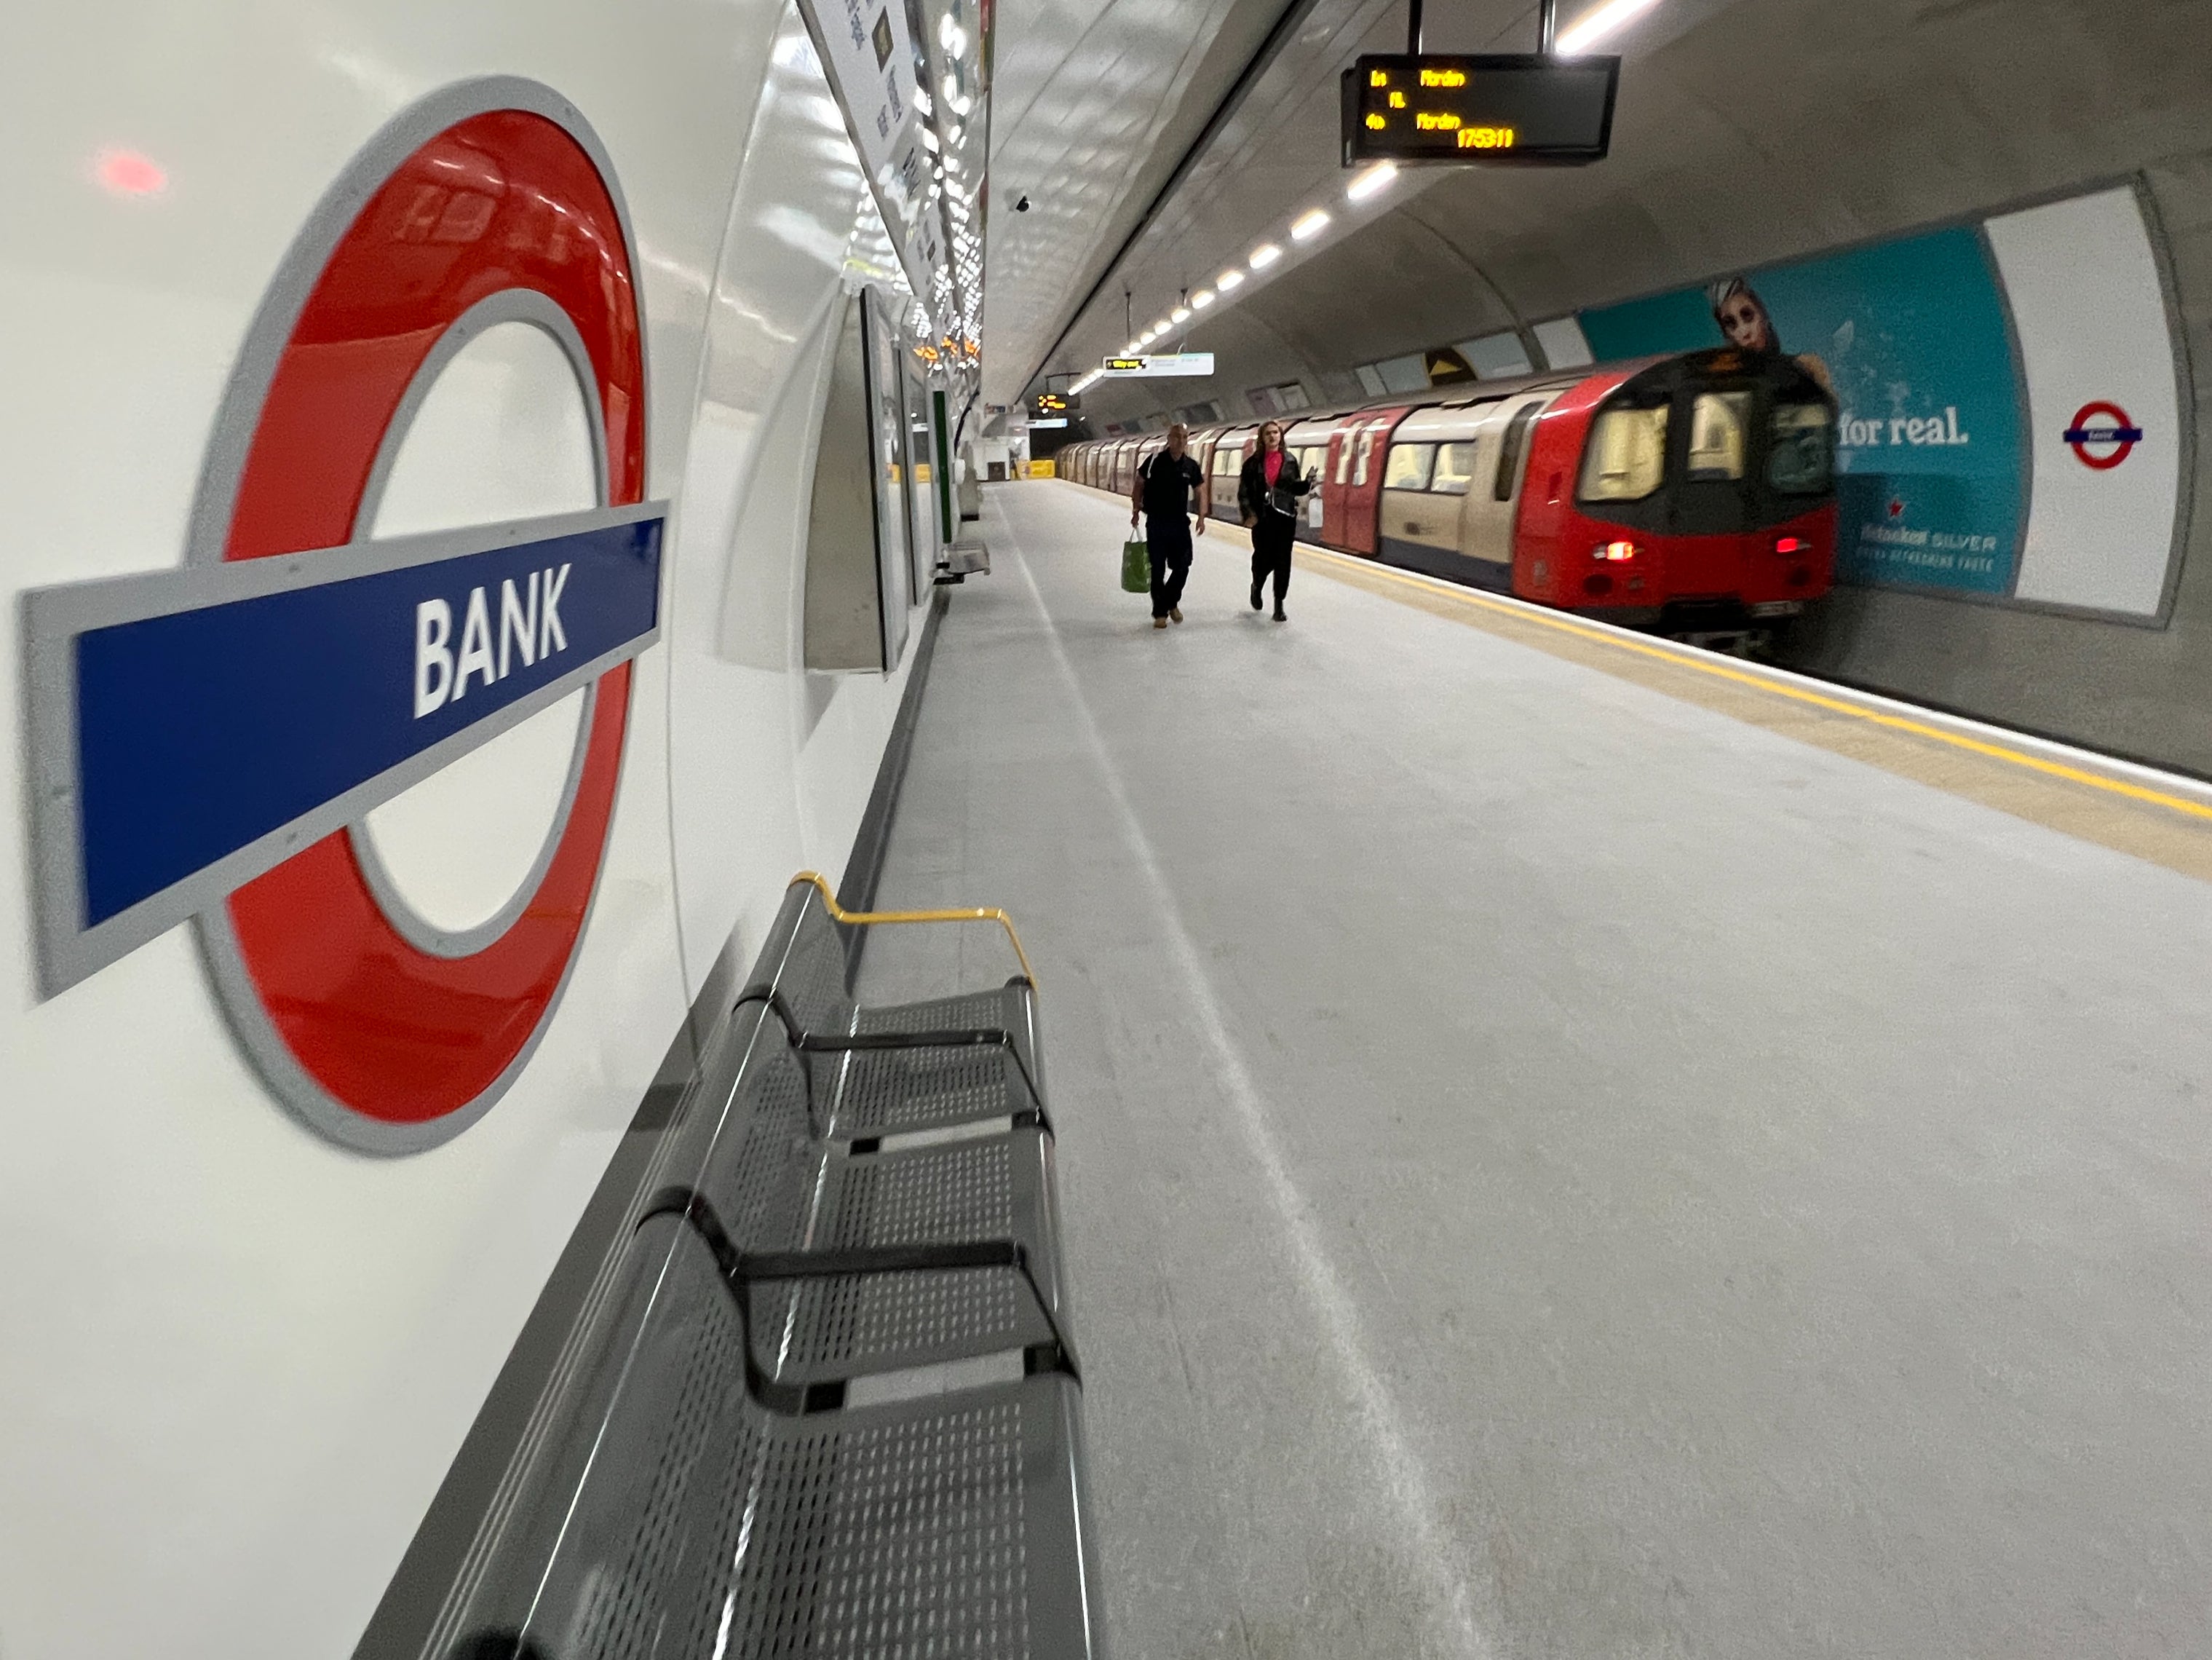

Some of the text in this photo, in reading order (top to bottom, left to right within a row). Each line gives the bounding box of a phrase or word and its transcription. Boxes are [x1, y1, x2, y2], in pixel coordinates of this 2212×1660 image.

[1416, 113, 1461, 130] Morden
[1839, 406, 1969, 446] for real.
[1931, 532, 1997, 553] SILVER
[413, 562, 573, 720] BANK
